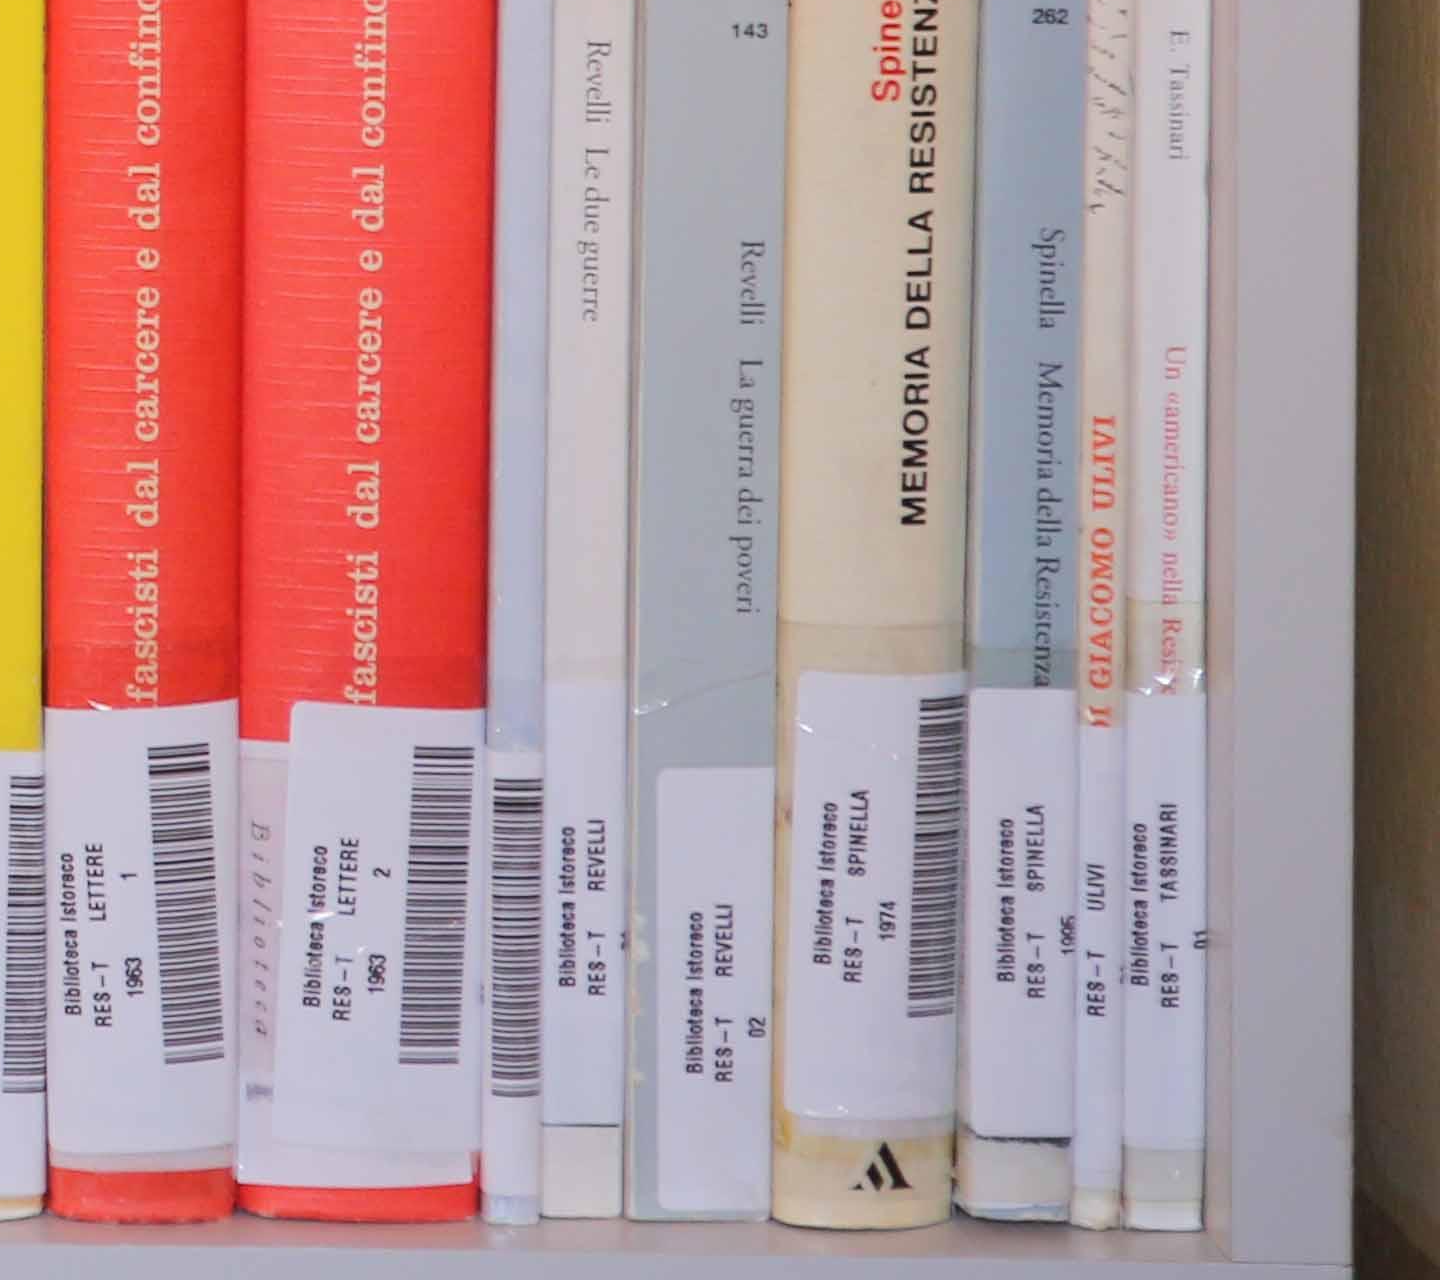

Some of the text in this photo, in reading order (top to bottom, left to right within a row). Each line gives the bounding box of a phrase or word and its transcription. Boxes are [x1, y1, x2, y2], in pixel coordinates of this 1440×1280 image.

[127, 163, 161, 230] dal
[133, 250, 161, 272] e
[902, 210, 935, 331] DELLA
[129, 286, 161, 440] carcere
[730, 240, 765, 616] Revelli La guerra dei poveri
[899, 346, 932, 526] MEMORIA
[127, 458, 161, 527] dal
[850, 790, 869, 877] SPINELLA
